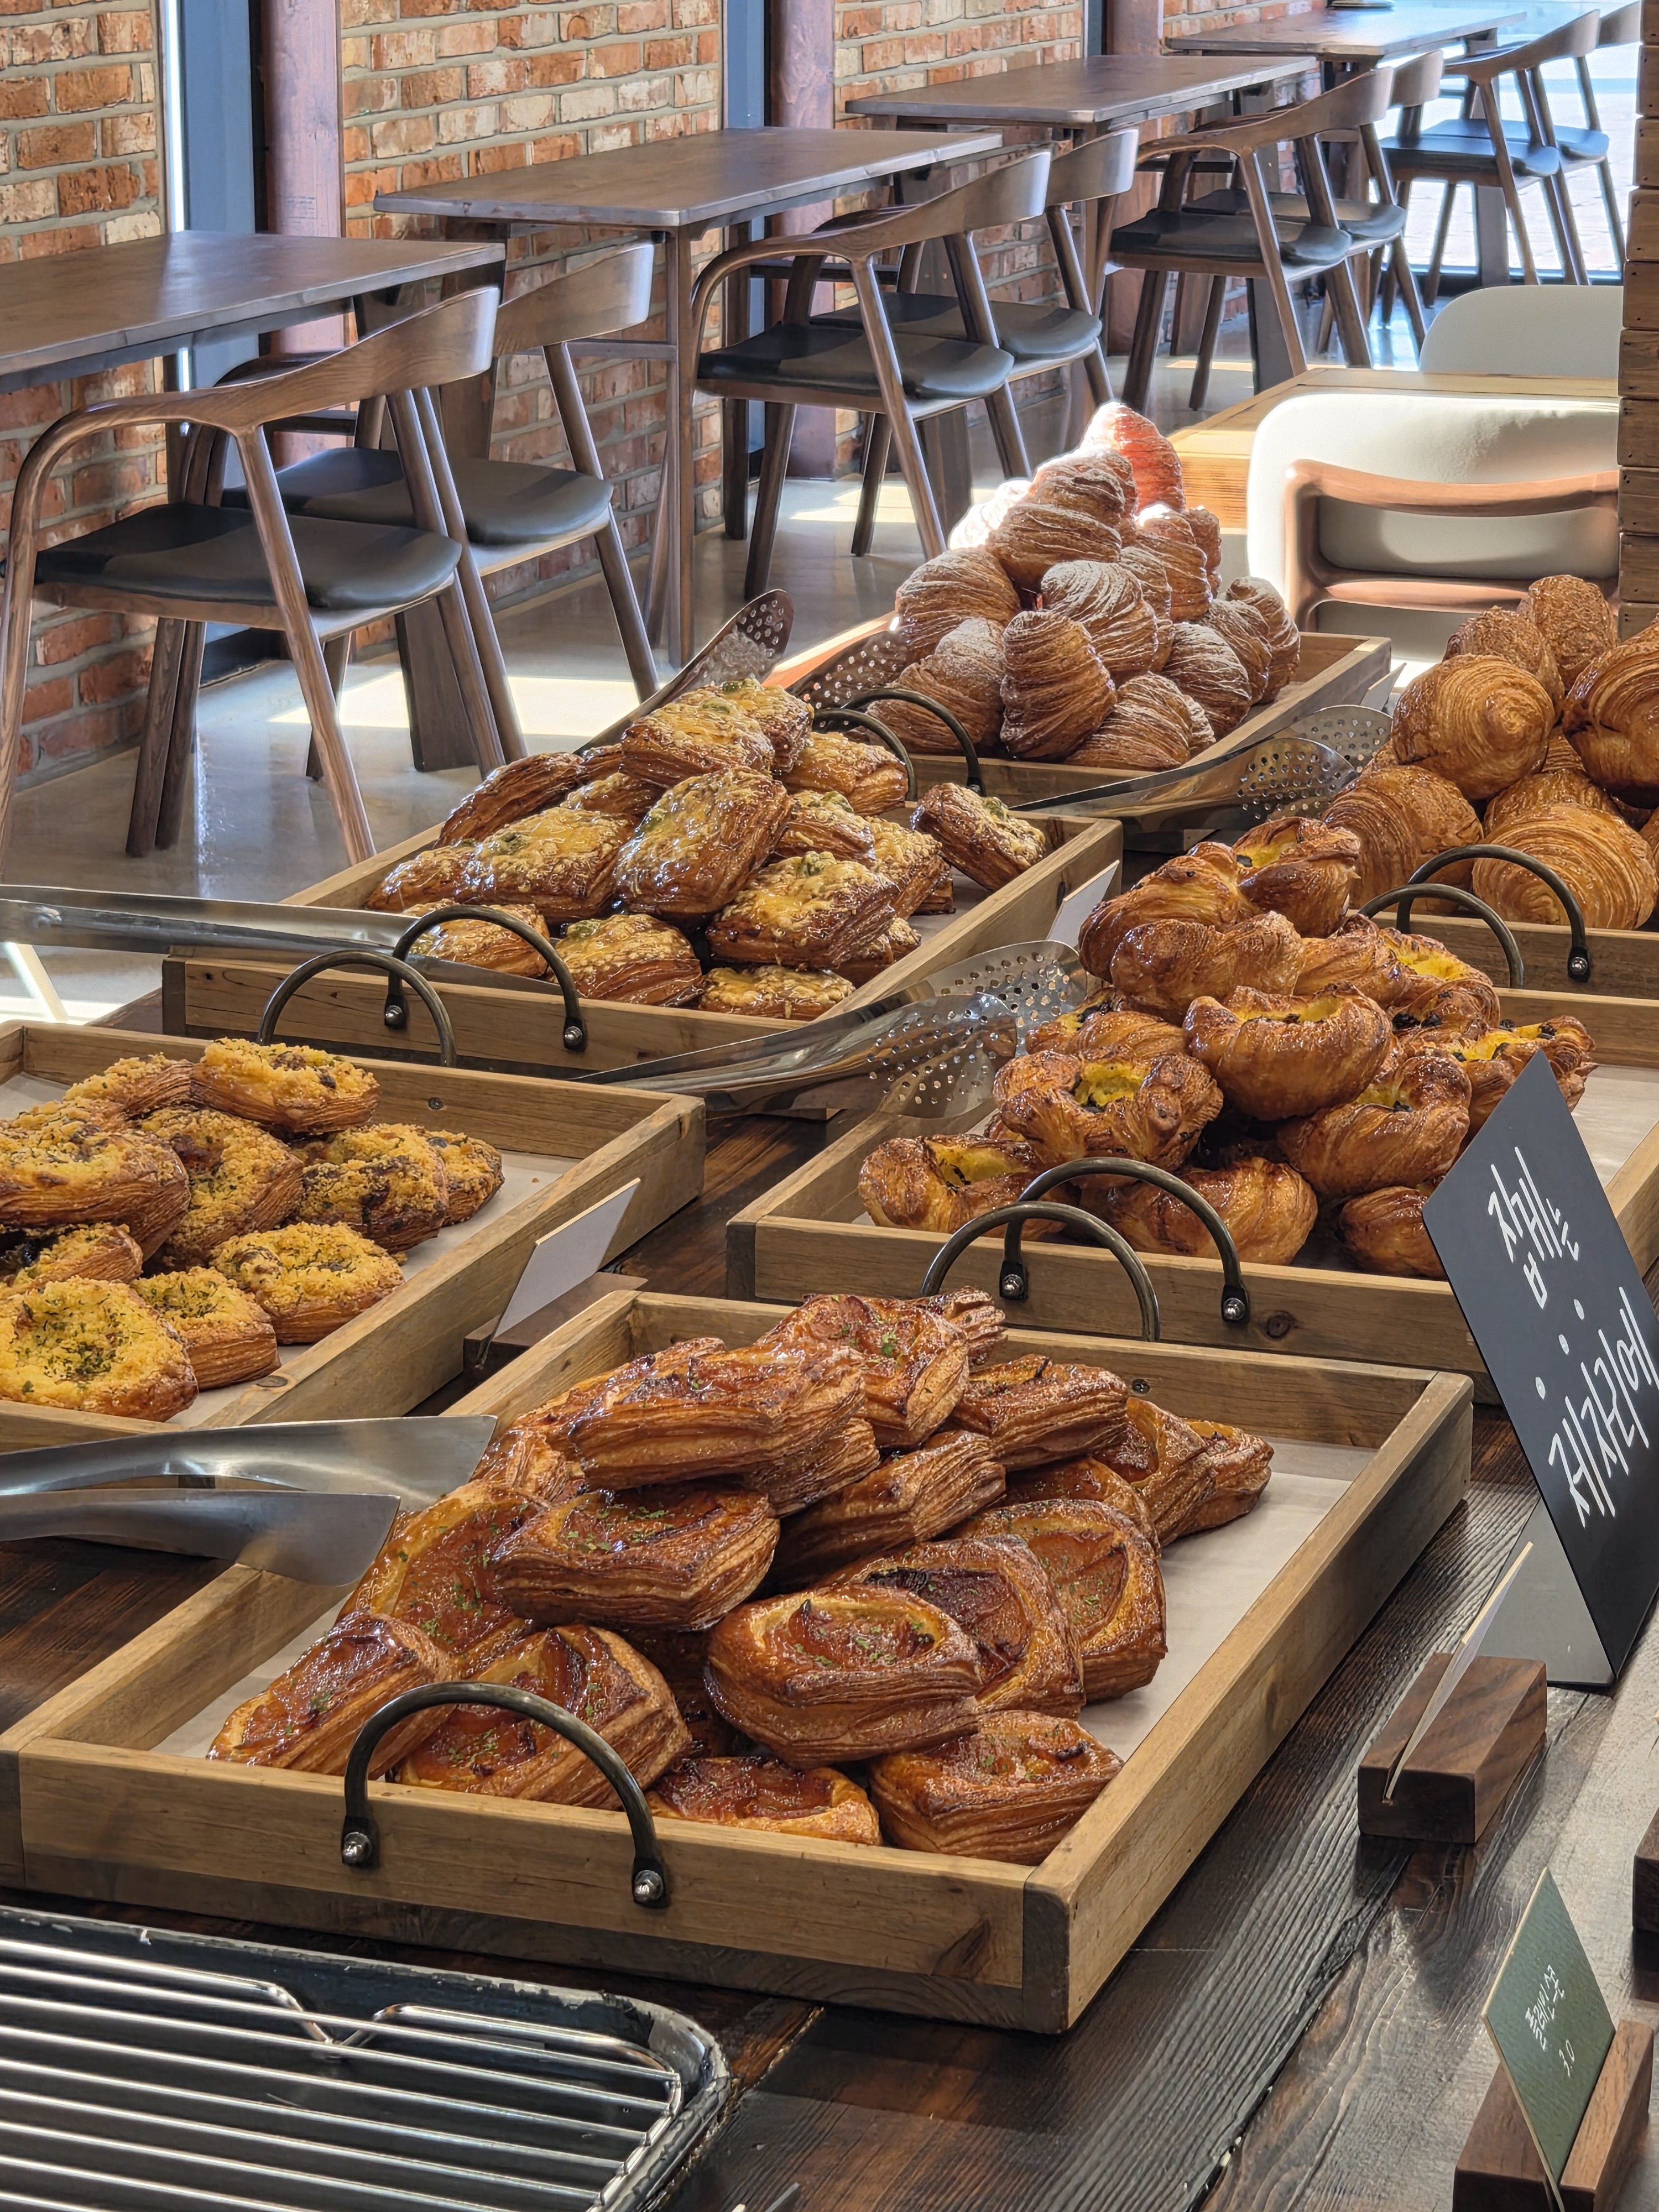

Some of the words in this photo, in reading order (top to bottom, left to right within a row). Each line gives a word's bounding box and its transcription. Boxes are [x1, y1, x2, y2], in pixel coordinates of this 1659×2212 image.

[1488, 1146, 1579, 1310] 집게는
[1548, 1286, 1659, 1528] 제자리에
[1558, 2039, 1575, 2078] 3.0
